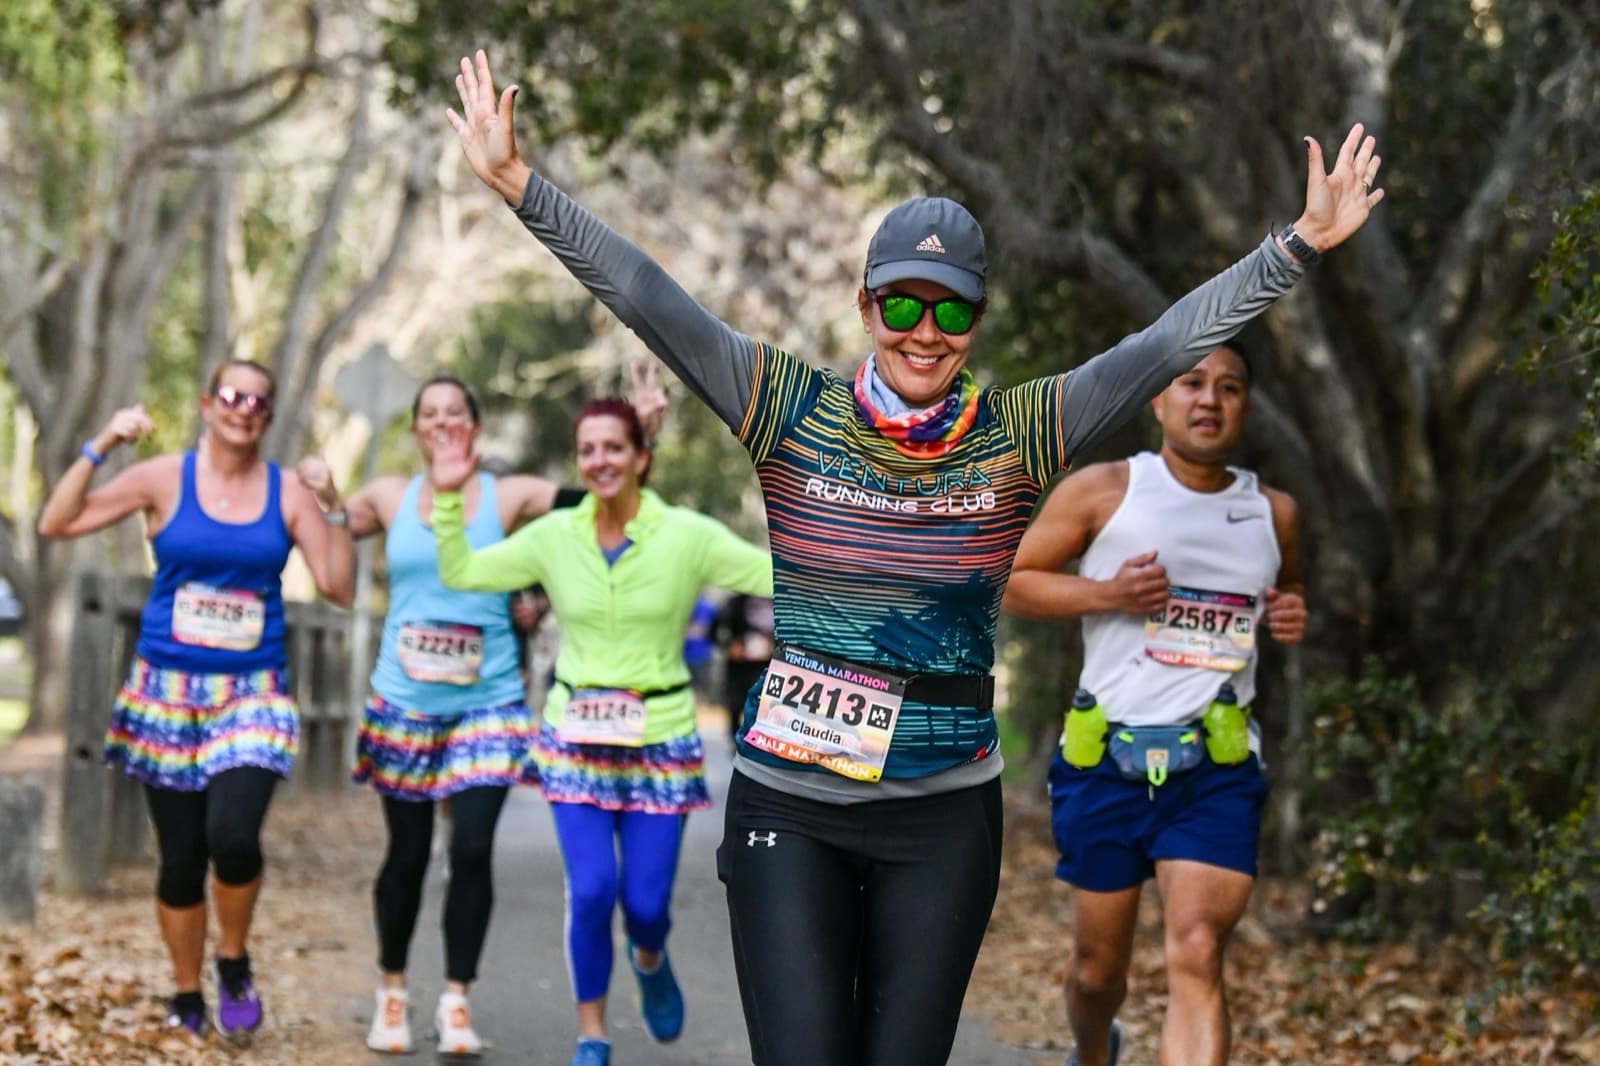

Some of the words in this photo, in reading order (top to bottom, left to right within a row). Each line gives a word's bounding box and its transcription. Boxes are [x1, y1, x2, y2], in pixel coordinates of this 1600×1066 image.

[915, 244, 946, 254] adidas
[818, 450, 992, 496] VENTURA
[805, 478, 918, 513] RUNNING
[930, 492, 996, 513] CLUB
[1168, 605, 1233, 634] 2587
[417, 634, 466, 656] 2224
[785, 652, 825, 673] VENTURA
[828, 665, 890, 691] MARATHON
[581, 702, 627, 720] 2124
[782, 675, 867, 727] 2413
[790, 719, 842, 744] Claudia
[756, 735, 786, 751] HALF
[788, 746, 870, 777] MARATHON
